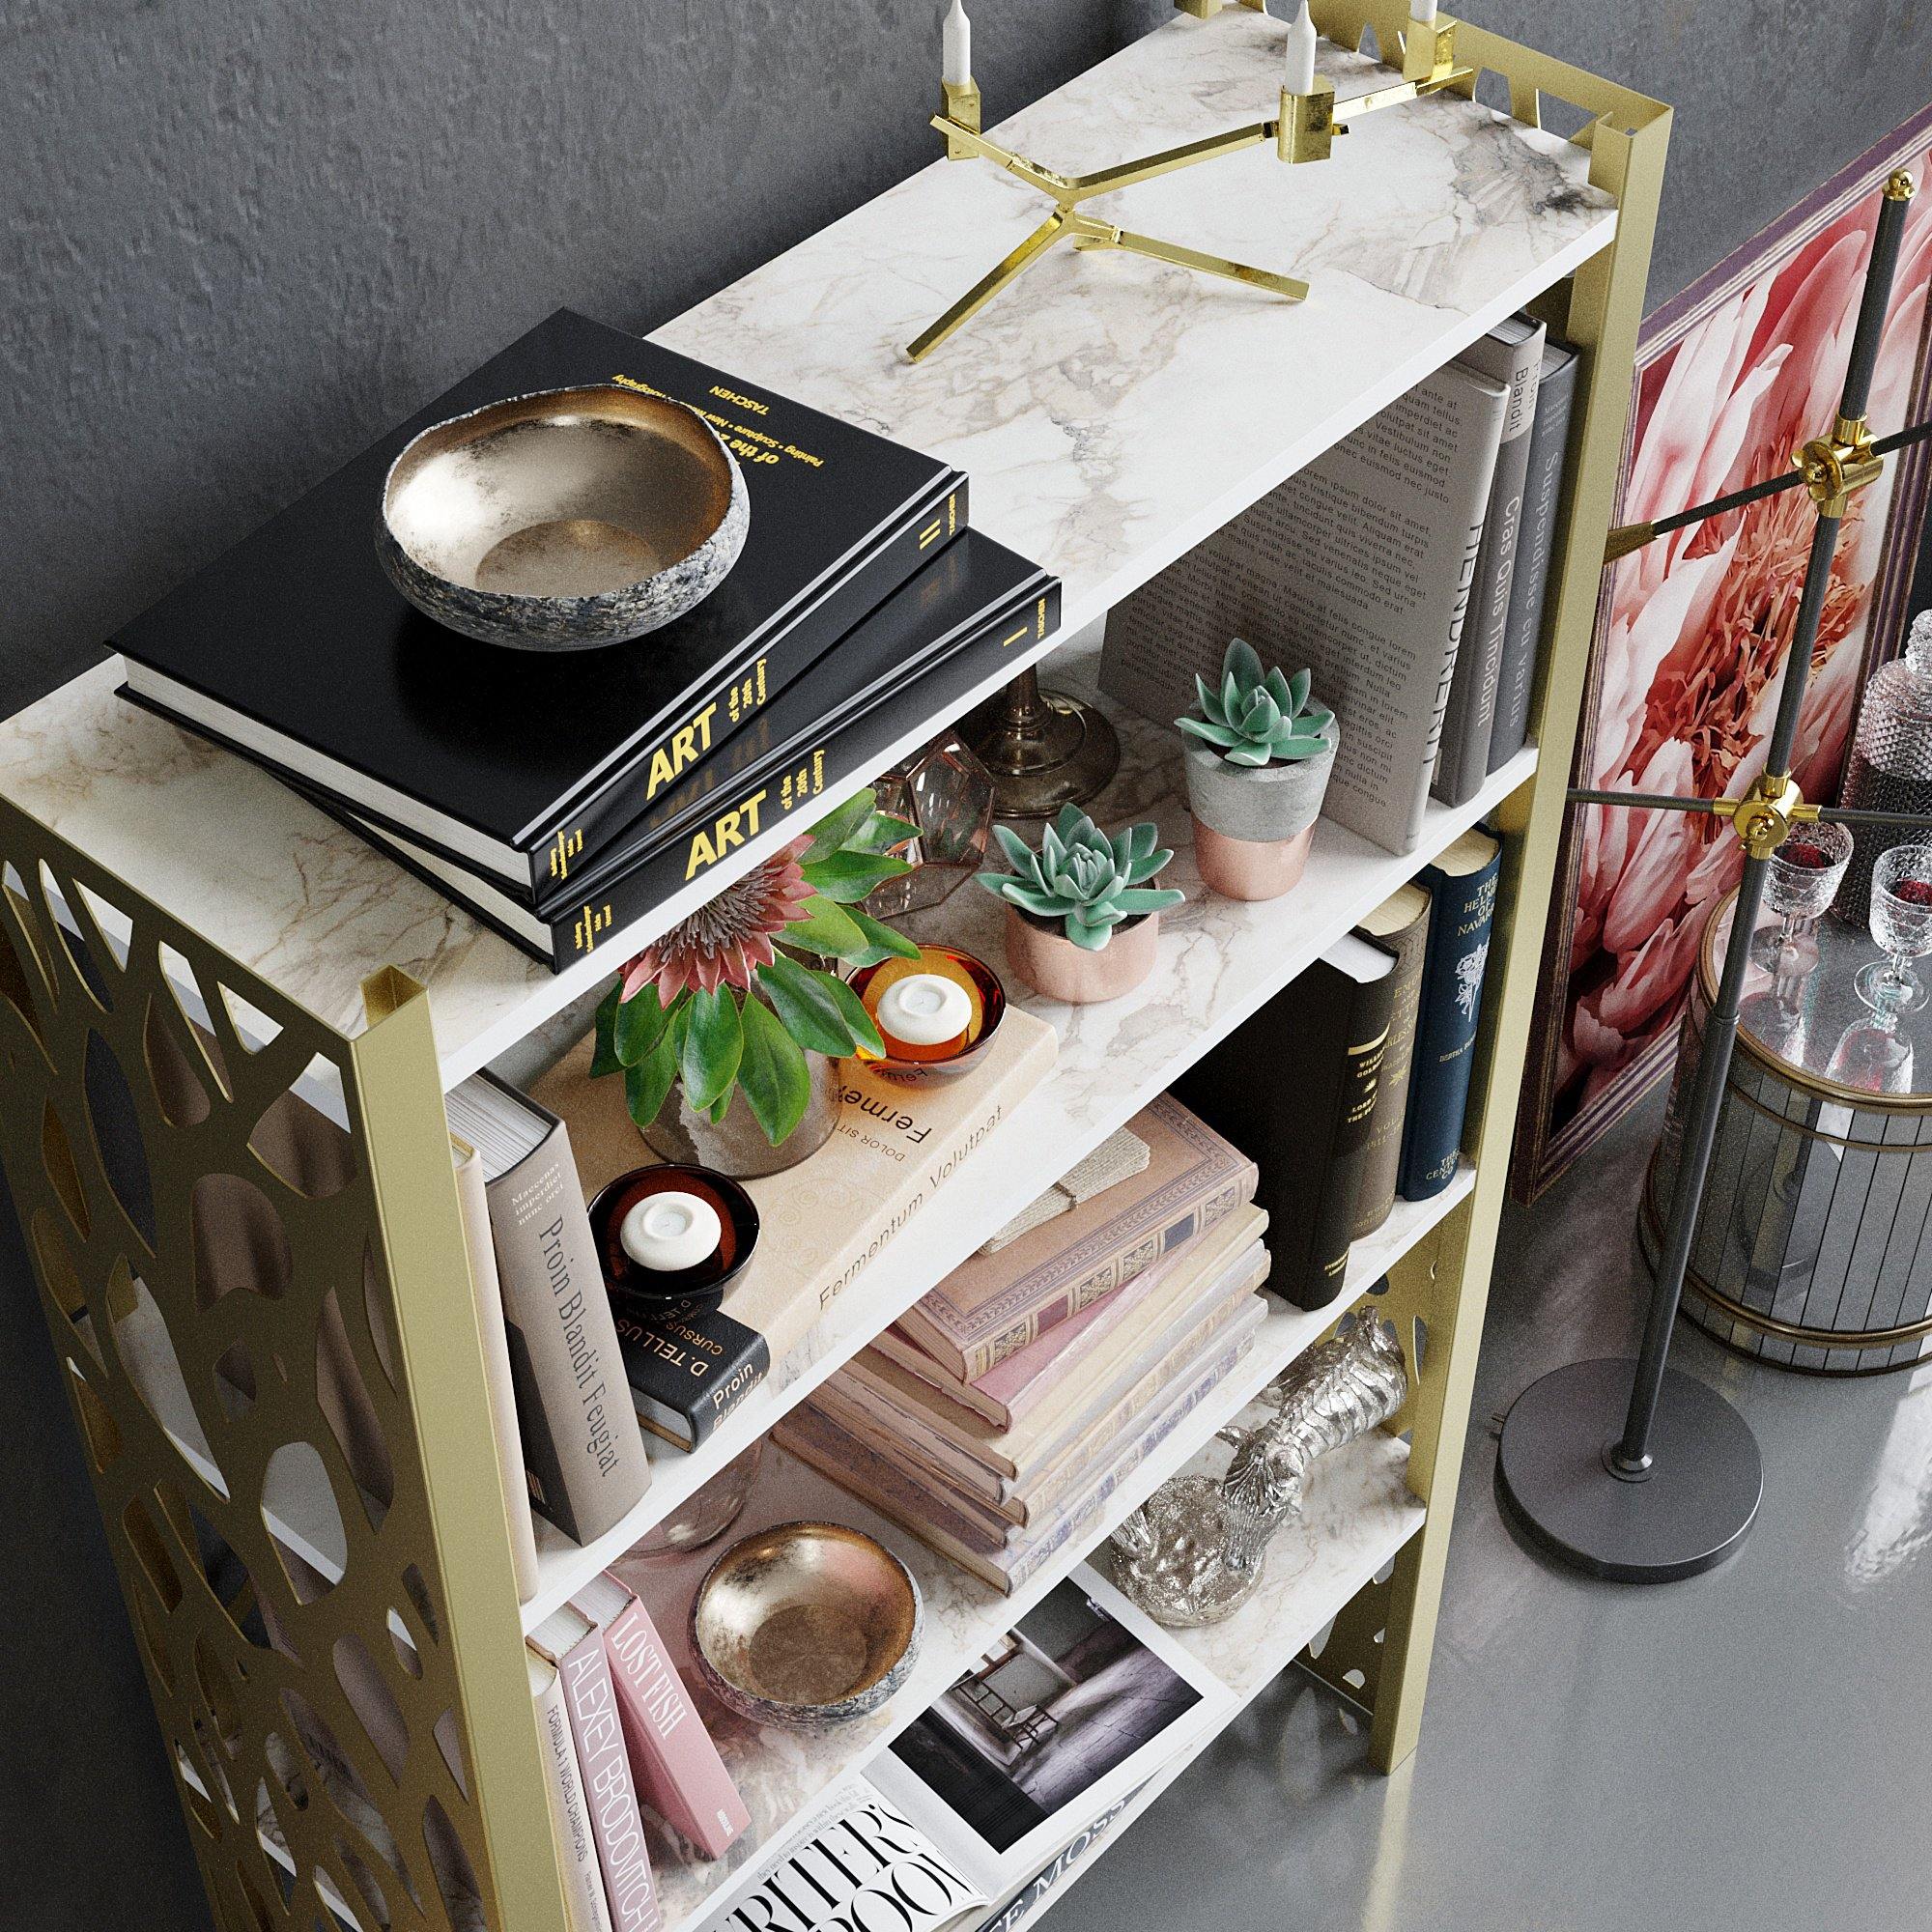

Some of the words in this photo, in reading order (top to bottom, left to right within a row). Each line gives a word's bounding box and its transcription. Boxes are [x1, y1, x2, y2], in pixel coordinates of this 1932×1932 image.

[709, 385, 771, 415] TASCHEN
[1421, 386, 1443, 404] ante
[1446, 398, 1457, 410] at
[1509, 367, 1529, 432] Blandit
[729, 439, 758, 457] the
[734, 424, 780, 449] Sculpture
[1445, 426, 1458, 438] ac
[753, 454, 780, 465] of
[784, 444, 825, 468] Painting
[1432, 448, 1450, 464] non
[1500, 496, 1520, 555] Cras
[1524, 452, 1559, 611] Suspendisse
[1492, 558, 1512, 617] Quis
[1520, 618, 1532, 647] eu
[755, 658, 767, 706] Century
[1477, 616, 1503, 727] Tincidunt
[1509, 653, 1528, 728] varius
[728, 686, 739, 709] the
[645, 702, 717, 802] ART
[812, 749, 825, 795] Century
[781, 775, 792, 798] the
[684, 789, 767, 882] ART
[861, 1134, 905, 1162] DOLOR
[511, 1163, 559, 1206] Maecenas
[515, 1172, 561, 1215] imperdiet
[519, 1204, 542, 1226] nunc
[546, 1184, 564, 1204] orci
[819, 1191, 923, 1311] Fermentum
[929, 1105, 1003, 1189] Volutpat
[539, 1215, 574, 1297] Proin
[558, 1291, 598, 1389] Blandit
[582, 1381, 620, 1478] Feugiat
[713, 1363, 753, 1409] Proin
[611, 1612, 662, 1685] LOST
[640, 1670, 688, 1739] FISH
[568, 1649, 617, 1763] ALEXEY
[546, 1704, 565, 1758] FORMULA
[559, 1763, 576, 1804] WORLD
[567, 1803, 587, 1861] CHAMPIONS
[592, 1754, 654, 1932] BRODOVITCH
